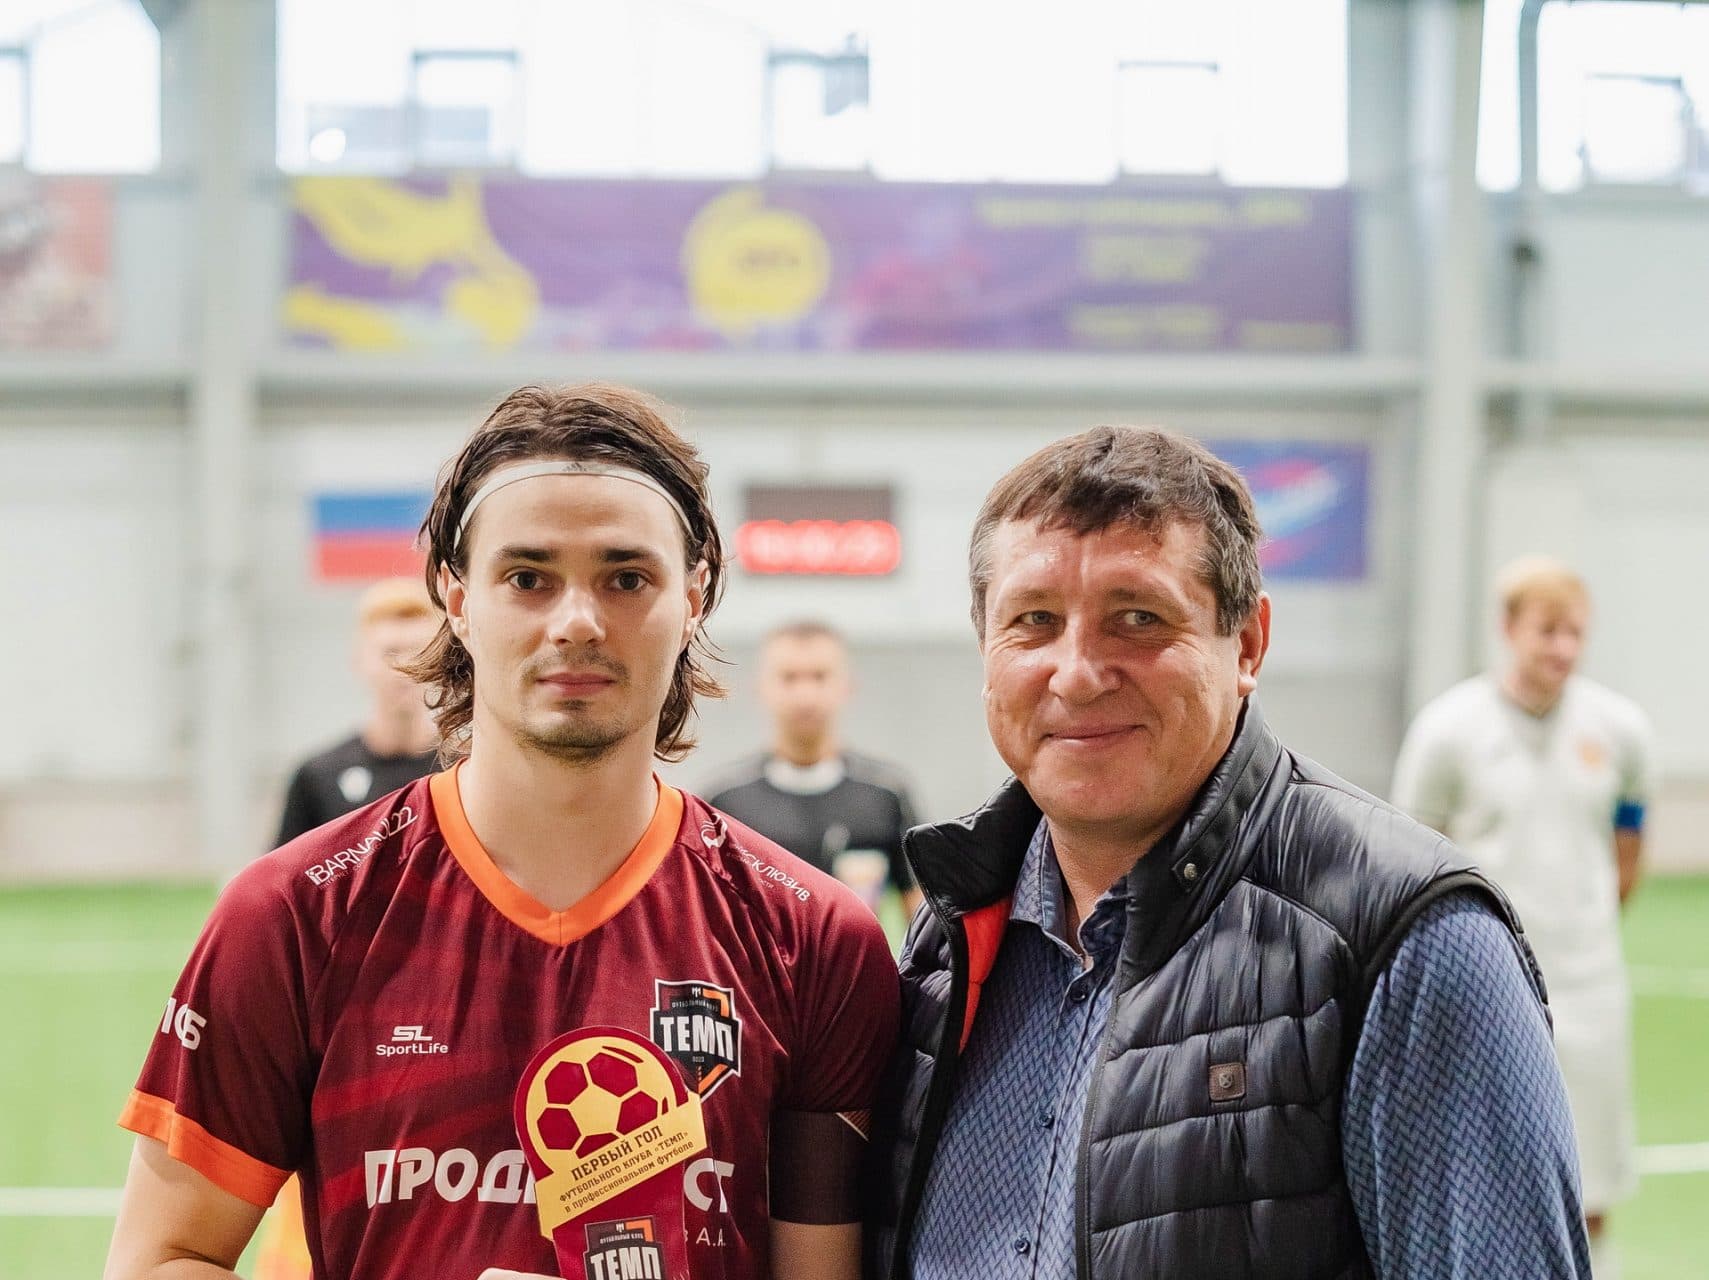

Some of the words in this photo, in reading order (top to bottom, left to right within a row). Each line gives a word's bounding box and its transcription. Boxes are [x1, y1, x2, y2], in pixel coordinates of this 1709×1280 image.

[376, 1043, 449, 1057] SportLife
[660, 1014, 734, 1062] ТЕМП
[559, 1165, 622, 1202] ФУТБОЛЬНОГО
[623, 1150, 653, 1169] КЛУБА
[571, 1139, 633, 1181] ПЕРВЫЙ
[635, 1125, 663, 1148] ГОЛ
[573, 1162, 656, 1208] профессиональном
[656, 1141, 694, 1165] футболе
